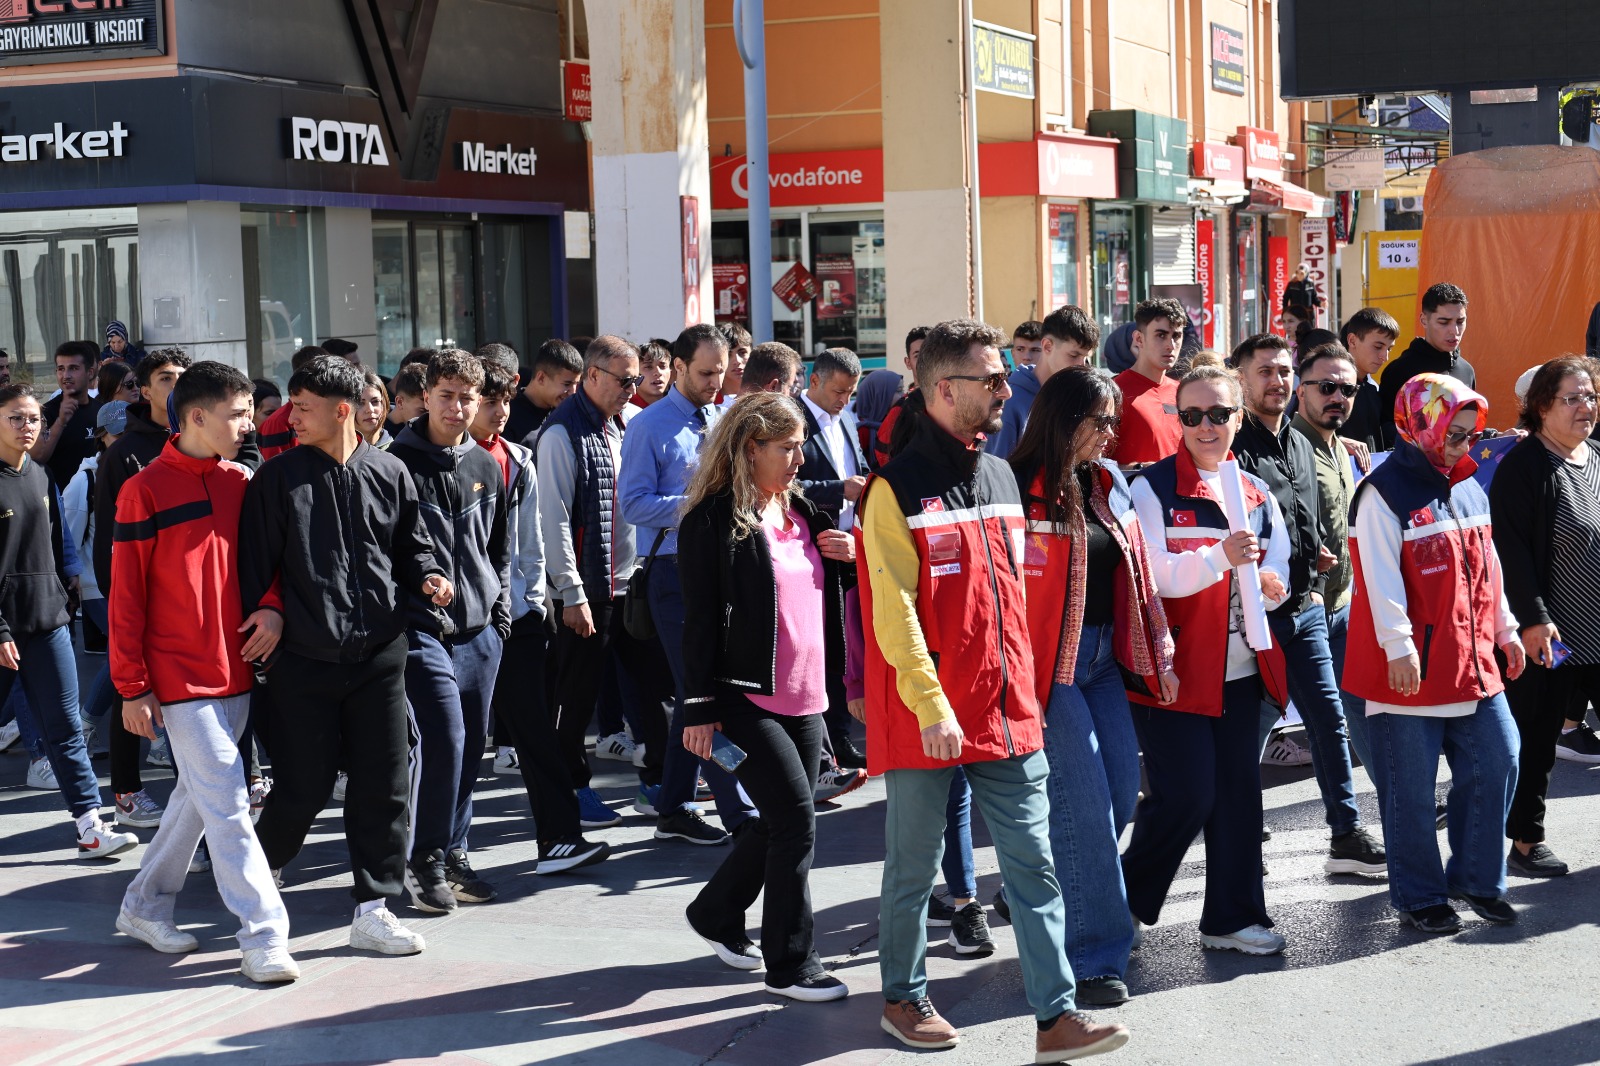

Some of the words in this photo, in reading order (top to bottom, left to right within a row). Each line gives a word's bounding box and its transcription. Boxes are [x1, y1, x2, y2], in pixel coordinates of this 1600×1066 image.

[572, 88, 591, 102] KARA
[1, 121, 128, 162] arket
[292, 116, 389, 166] ROTA
[463, 141, 537, 176] Market
[768, 166, 862, 188] vodafone
[1197, 243, 1209, 304] vodafone
[1386, 253, 1402, 263] 10
